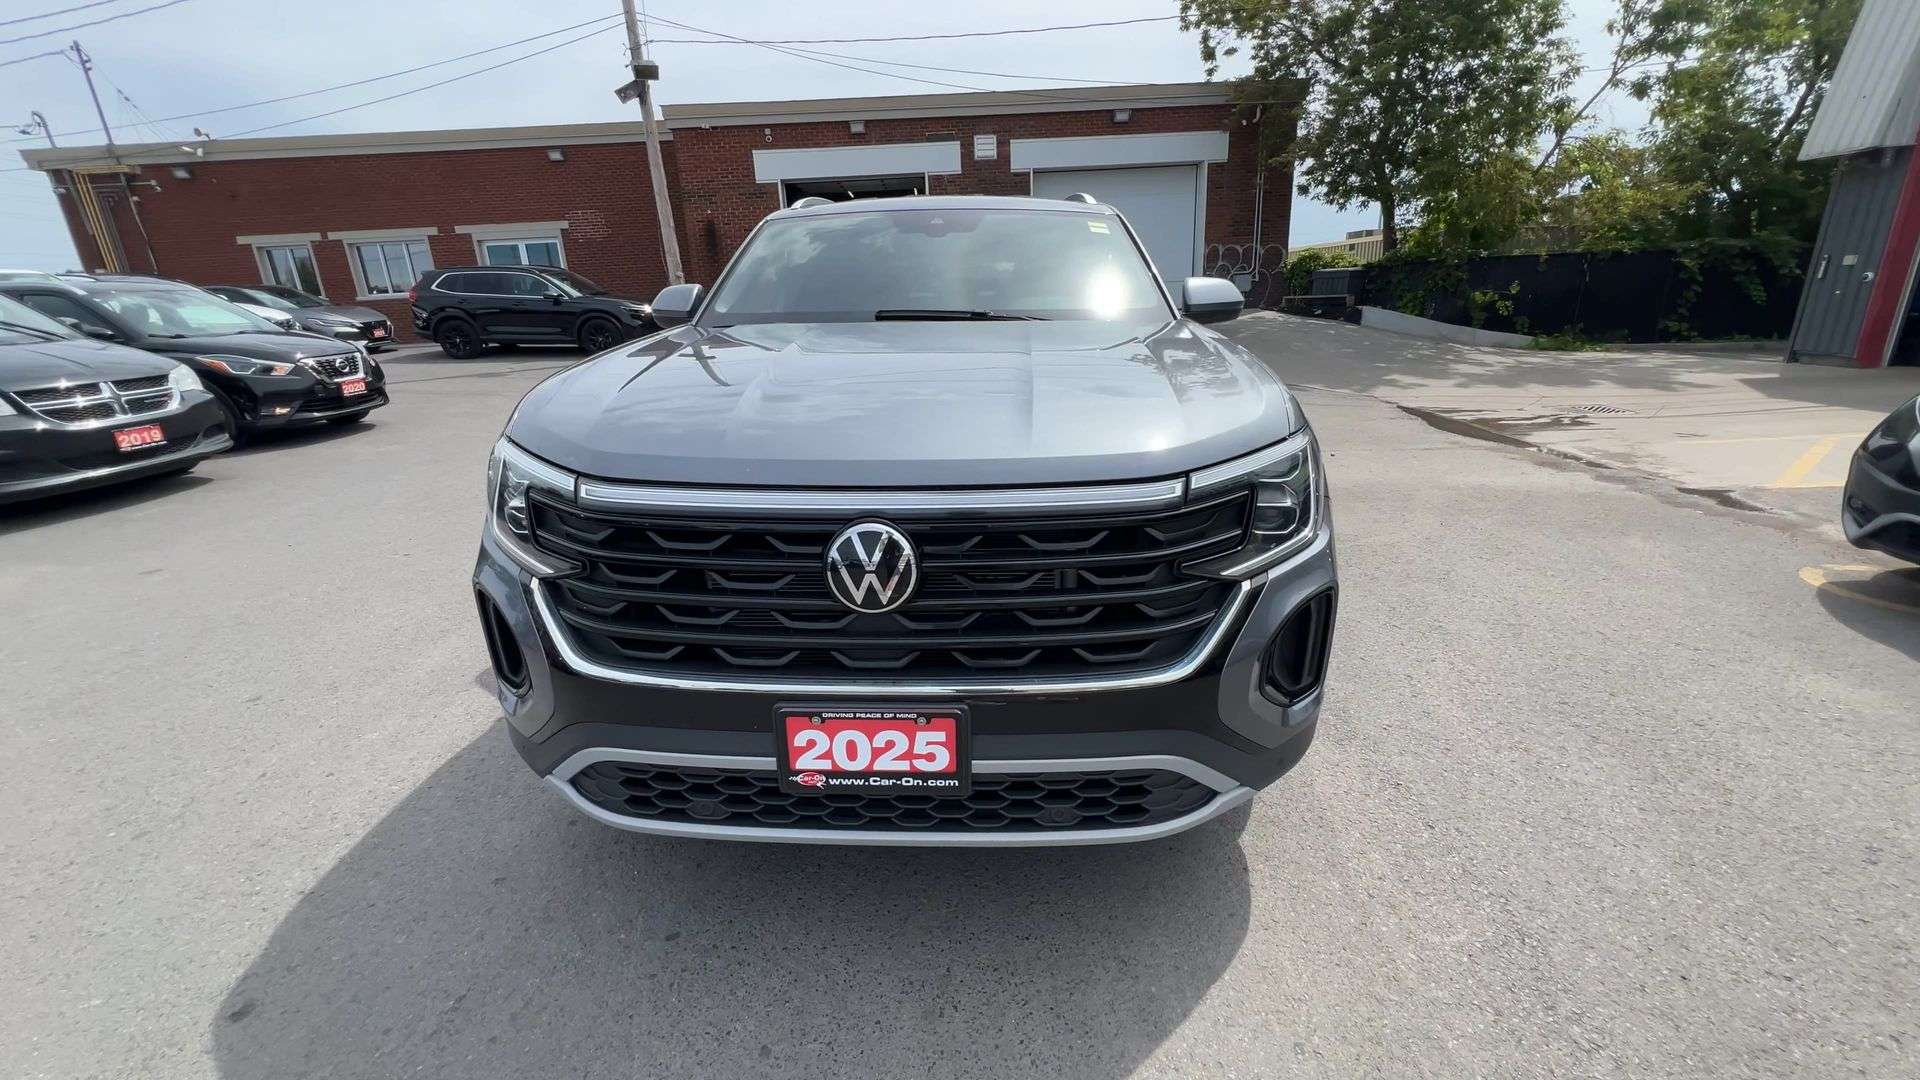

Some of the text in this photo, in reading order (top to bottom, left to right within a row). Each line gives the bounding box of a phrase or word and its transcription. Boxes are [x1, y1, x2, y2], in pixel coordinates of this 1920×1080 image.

[342, 381, 366, 393] 2020
[118, 430, 162, 448] 2019
[793, 729, 950, 772] 2025
[828, 777, 959, 787] www.Car-On.com
